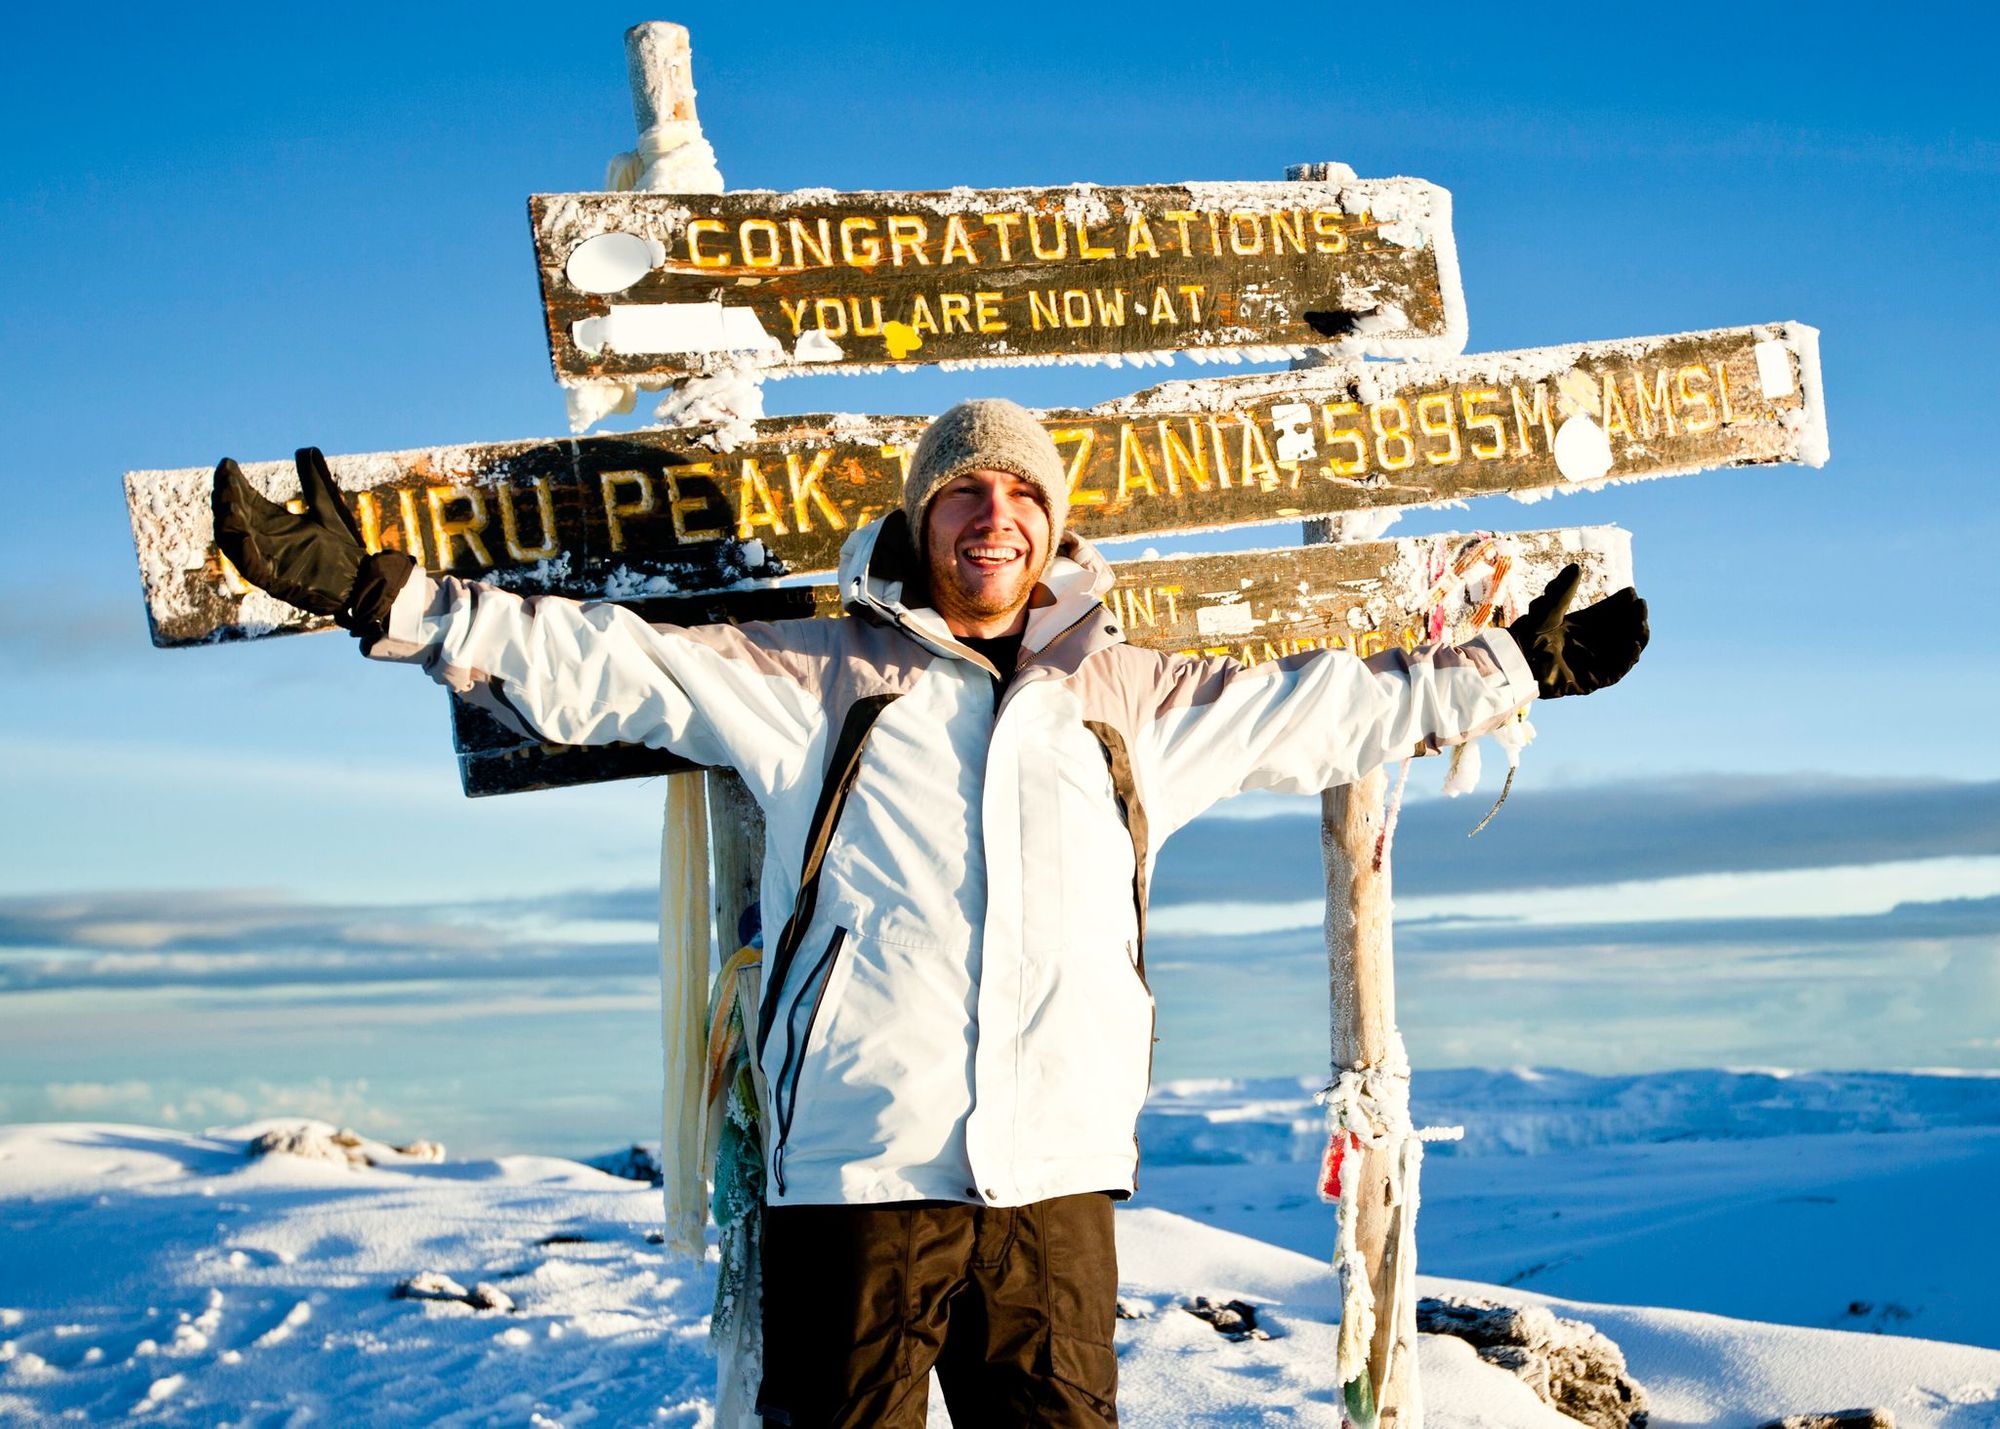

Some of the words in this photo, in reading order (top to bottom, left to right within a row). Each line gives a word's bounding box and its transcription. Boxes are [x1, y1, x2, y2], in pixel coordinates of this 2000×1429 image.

[780, 297, 883, 338] YOU
[911, 291, 1008, 333] ARE
[1029, 286, 1127, 331] NOW
[1151, 285, 1206, 325] AT
